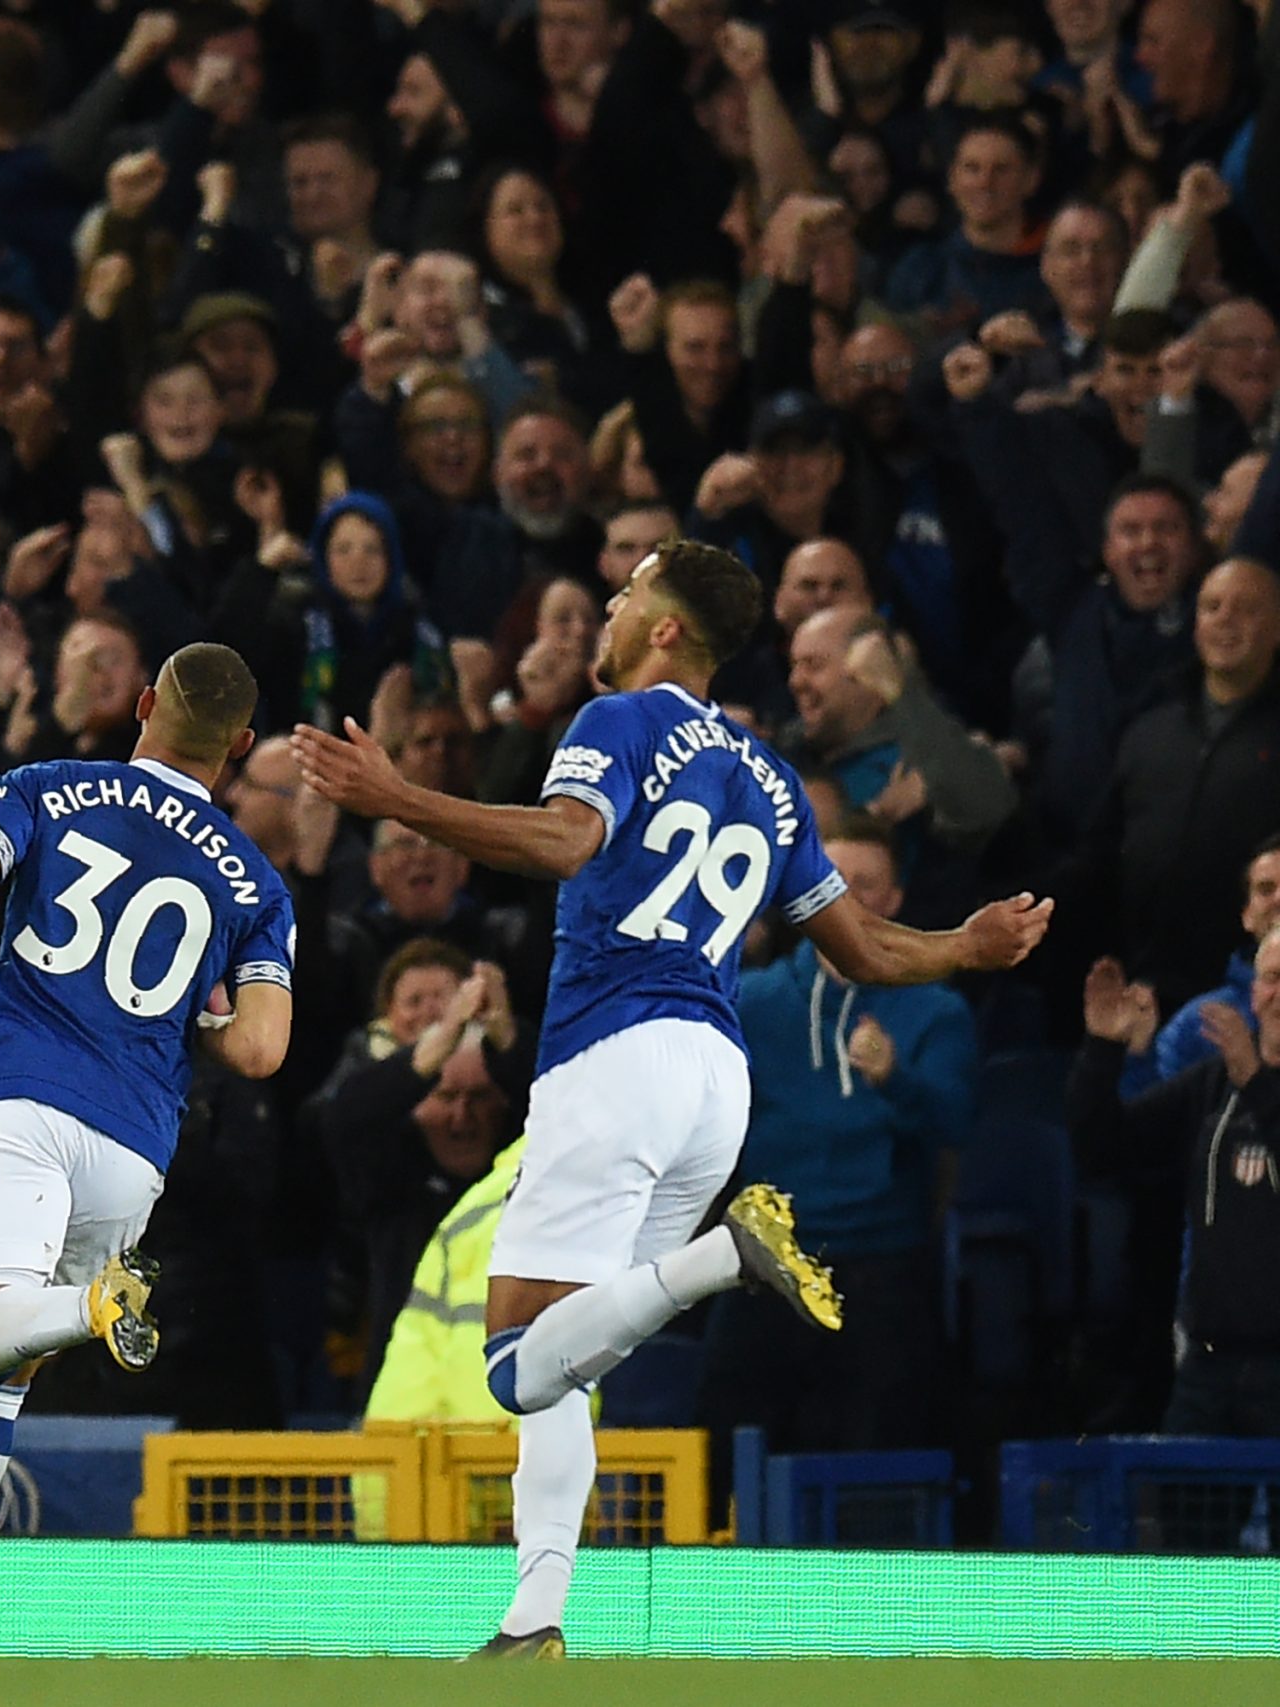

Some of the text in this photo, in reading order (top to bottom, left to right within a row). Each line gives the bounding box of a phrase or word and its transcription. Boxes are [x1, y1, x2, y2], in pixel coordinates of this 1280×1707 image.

[12, 829, 212, 1017] 30
[41, 778, 260, 905] RICHARLISON
[616, 799, 771, 967] 29
